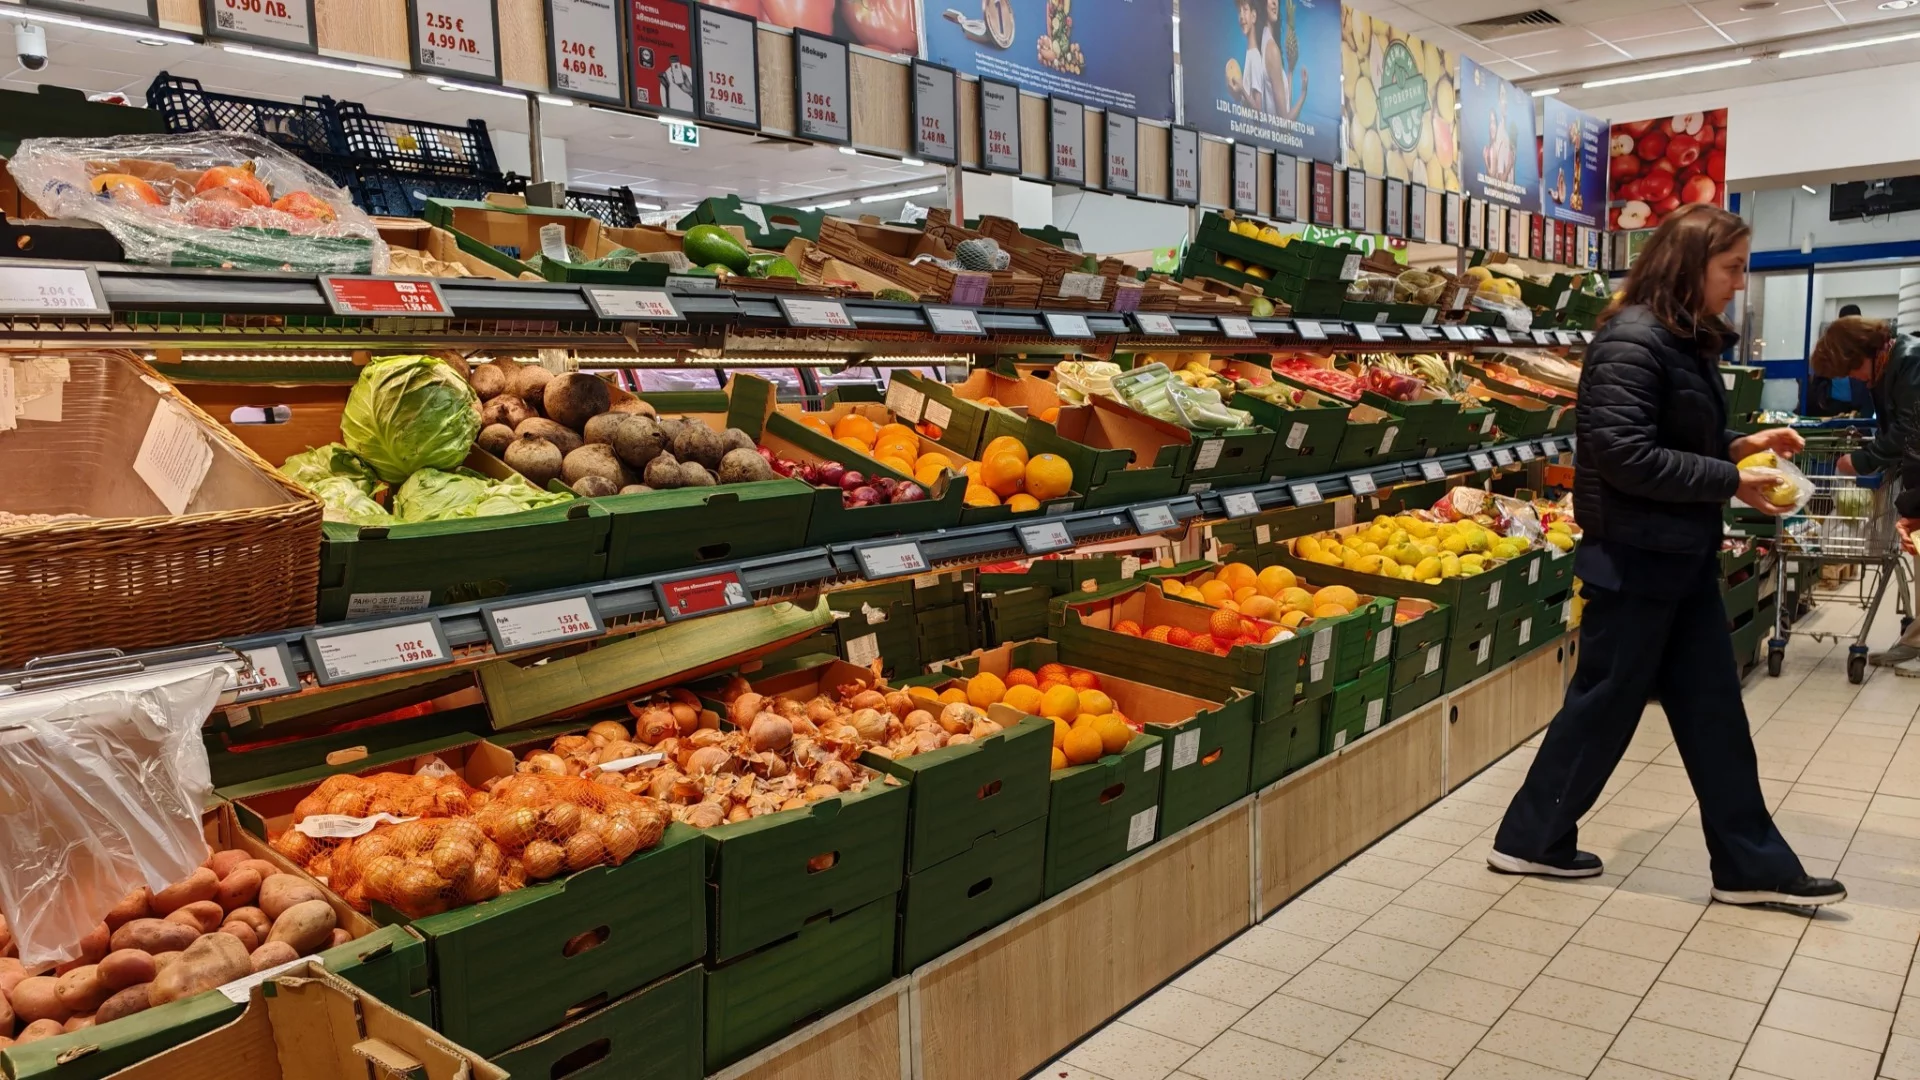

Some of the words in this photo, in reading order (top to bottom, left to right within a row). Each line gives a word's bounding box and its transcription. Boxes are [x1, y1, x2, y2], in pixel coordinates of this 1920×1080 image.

[265, 0, 291, 19] ЛВ.
[426, 12, 452, 30] 2.55
[456, 19, 464, 33] €
[636, 13, 686, 31] автоматично
[427, 32, 455, 49] 4.99
[459, 37, 480, 54] ЛВ.
[561, 40, 585, 57] 2.40
[588, 46, 595, 58] €
[563, 58, 586, 73] 4.69
[589, 63, 607, 78] ЛВ.
[709, 71, 726, 85] 1.53
[728, 75, 735, 87] €
[710, 88, 729, 102] 2.99
[731, 92, 746, 105] ЛВ.
[807, 92, 823, 105] 3.06
[826, 96, 831, 107] €
[1384, 85, 1421, 109] ПРОВЕРЕНИ
[808, 107, 824, 120] 5.98
[825, 111, 838, 123] ЛВ.
[921, 116, 934, 128] 1.27
[935, 119, 940, 129] €
[1216, 99, 1231, 113] LIDL
[1232, 104, 1258, 120] ПОМАГА
[1260, 111, 1268, 123] ЗА
[1268, 115, 1306, 133] РАЗВИТИЕТО
[1306, 125, 1315, 136] НА
[922, 129, 936, 142] 2.48
[936, 133, 947, 144] ЛВ.
[1230, 120, 1271, 140] БЪЛГАРСКИЯ
[1271, 131, 1304, 148] ВОЛЕЙБОЛ
[38, 286, 65, 295] 2.04
[41, 297, 67, 307] 3.99
[557, 615, 572, 624] 1.53
[573, 614, 579, 622] €
[561, 624, 578, 634] 2.99
[579, 621, 591, 630] ЛВ.
[395, 642, 416, 653] 1.02
[416, 640, 424, 649] €
[400, 652, 419, 663] 1.99
[420, 649, 436, 660] ЛВ.
[258, 667, 266, 677] €
